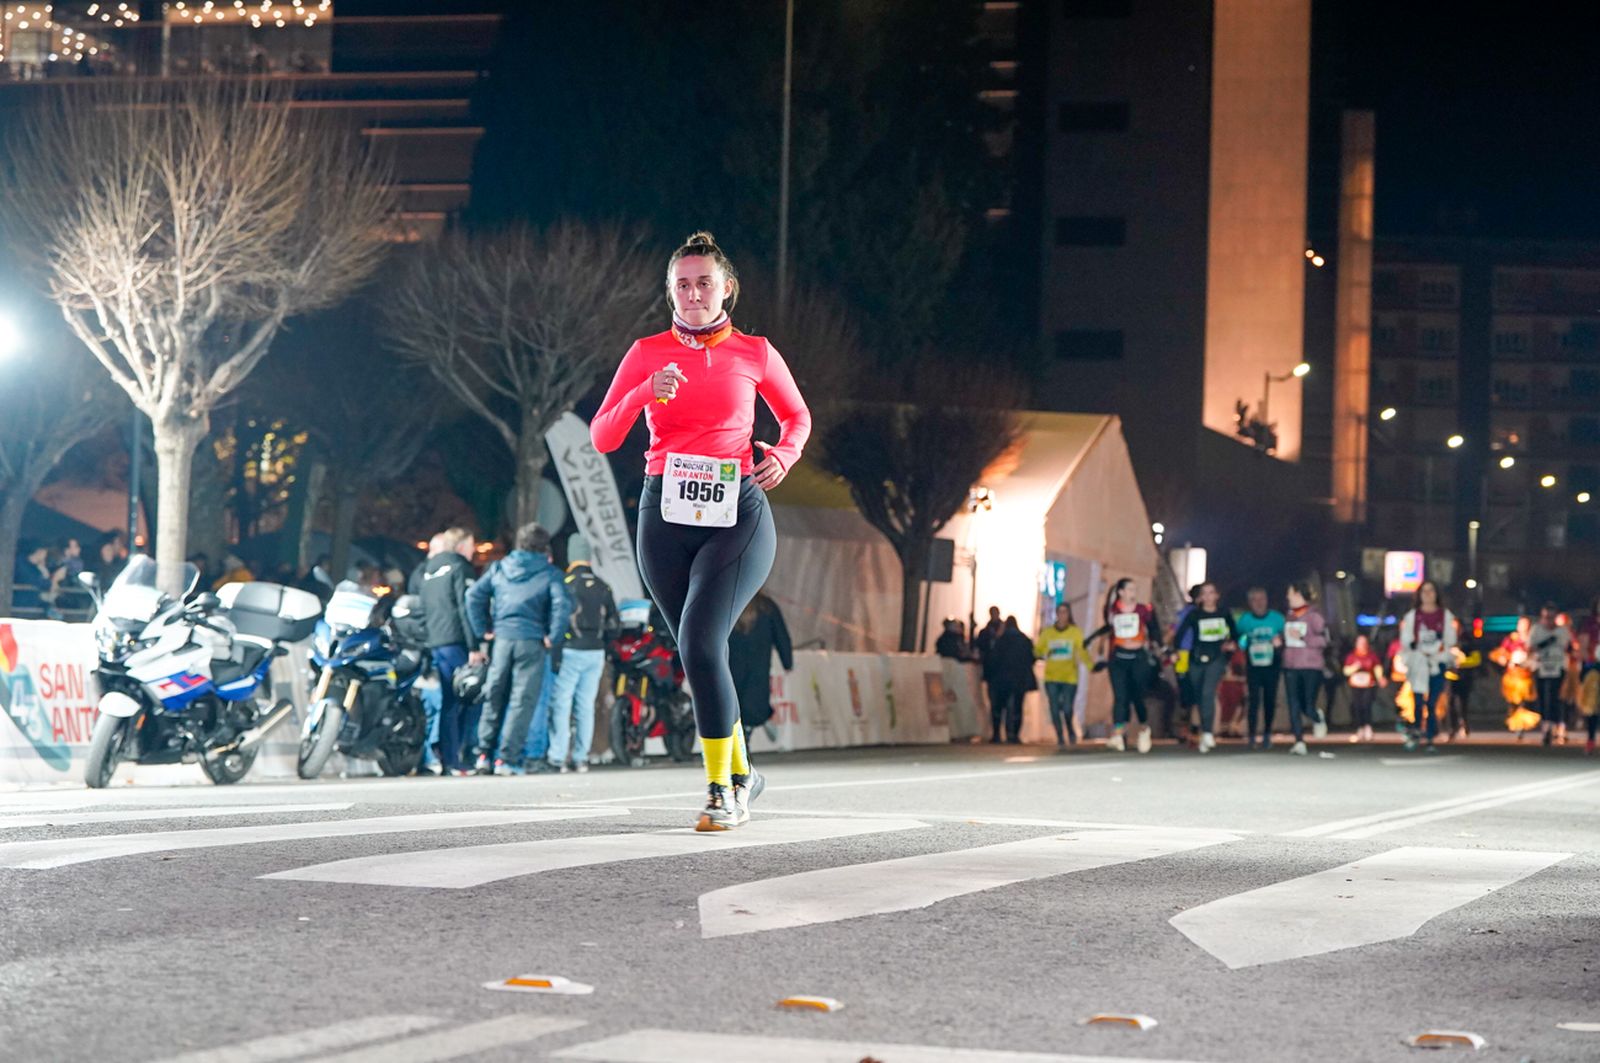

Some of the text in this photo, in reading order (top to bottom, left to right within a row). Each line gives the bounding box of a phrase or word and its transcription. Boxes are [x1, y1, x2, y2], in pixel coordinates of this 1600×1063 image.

[673, 470, 687, 478] SAN
[682, 462, 704, 471] NOCHE
[704, 464, 713, 472] DE
[580, 441, 631, 562] JAPEMASA
[678, 480, 726, 503] 1956
[39, 662, 85, 700] SAN
